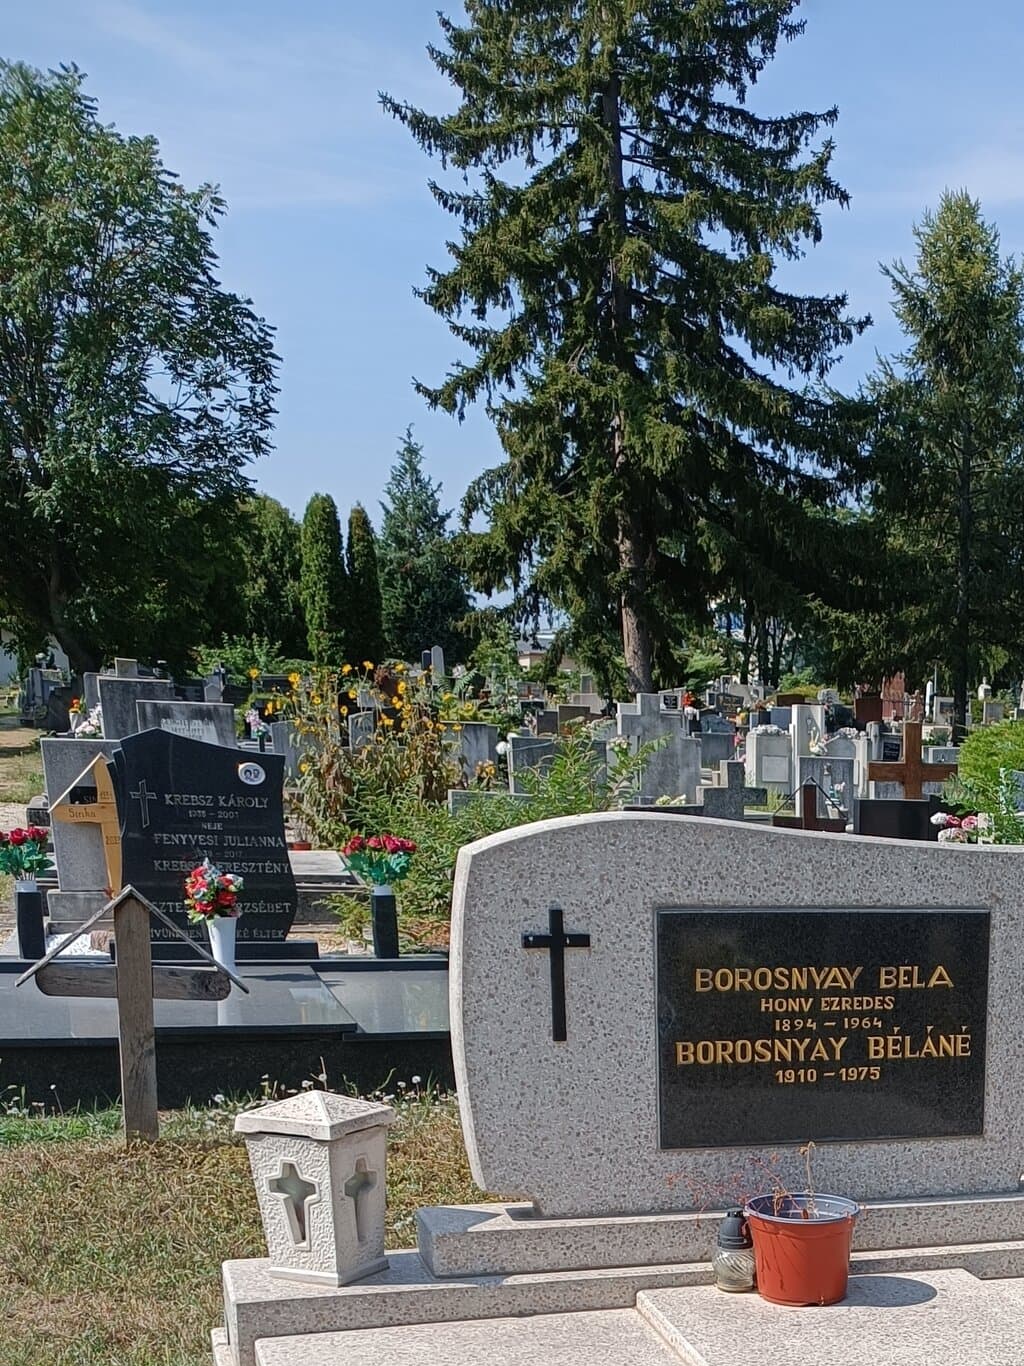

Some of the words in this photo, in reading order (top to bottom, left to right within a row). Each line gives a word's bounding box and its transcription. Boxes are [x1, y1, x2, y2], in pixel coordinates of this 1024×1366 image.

[164, 794, 214, 806] KREBSZ
[218, 793, 269, 808] KÁROLY
[154, 834, 219, 846] FENYVESI
[223, 835, 285, 847] JULIANNA
[216, 860, 290, 873] ERESZTÉNY
[694, 965, 865, 992] BOROSNYAY
[760, 997, 814, 1013] HONV
[820, 996, 895, 1011] EZREDES
[775, 1018, 817, 1031] 1894
[843, 1017, 883, 1030] 1964
[675, 1036, 848, 1065] BOROSNYAY
[866, 1025, 971, 1060] BÉLÁNÉ
[775, 1068, 817, 1083] 1910
[839, 1066, 881, 1081] 1975
